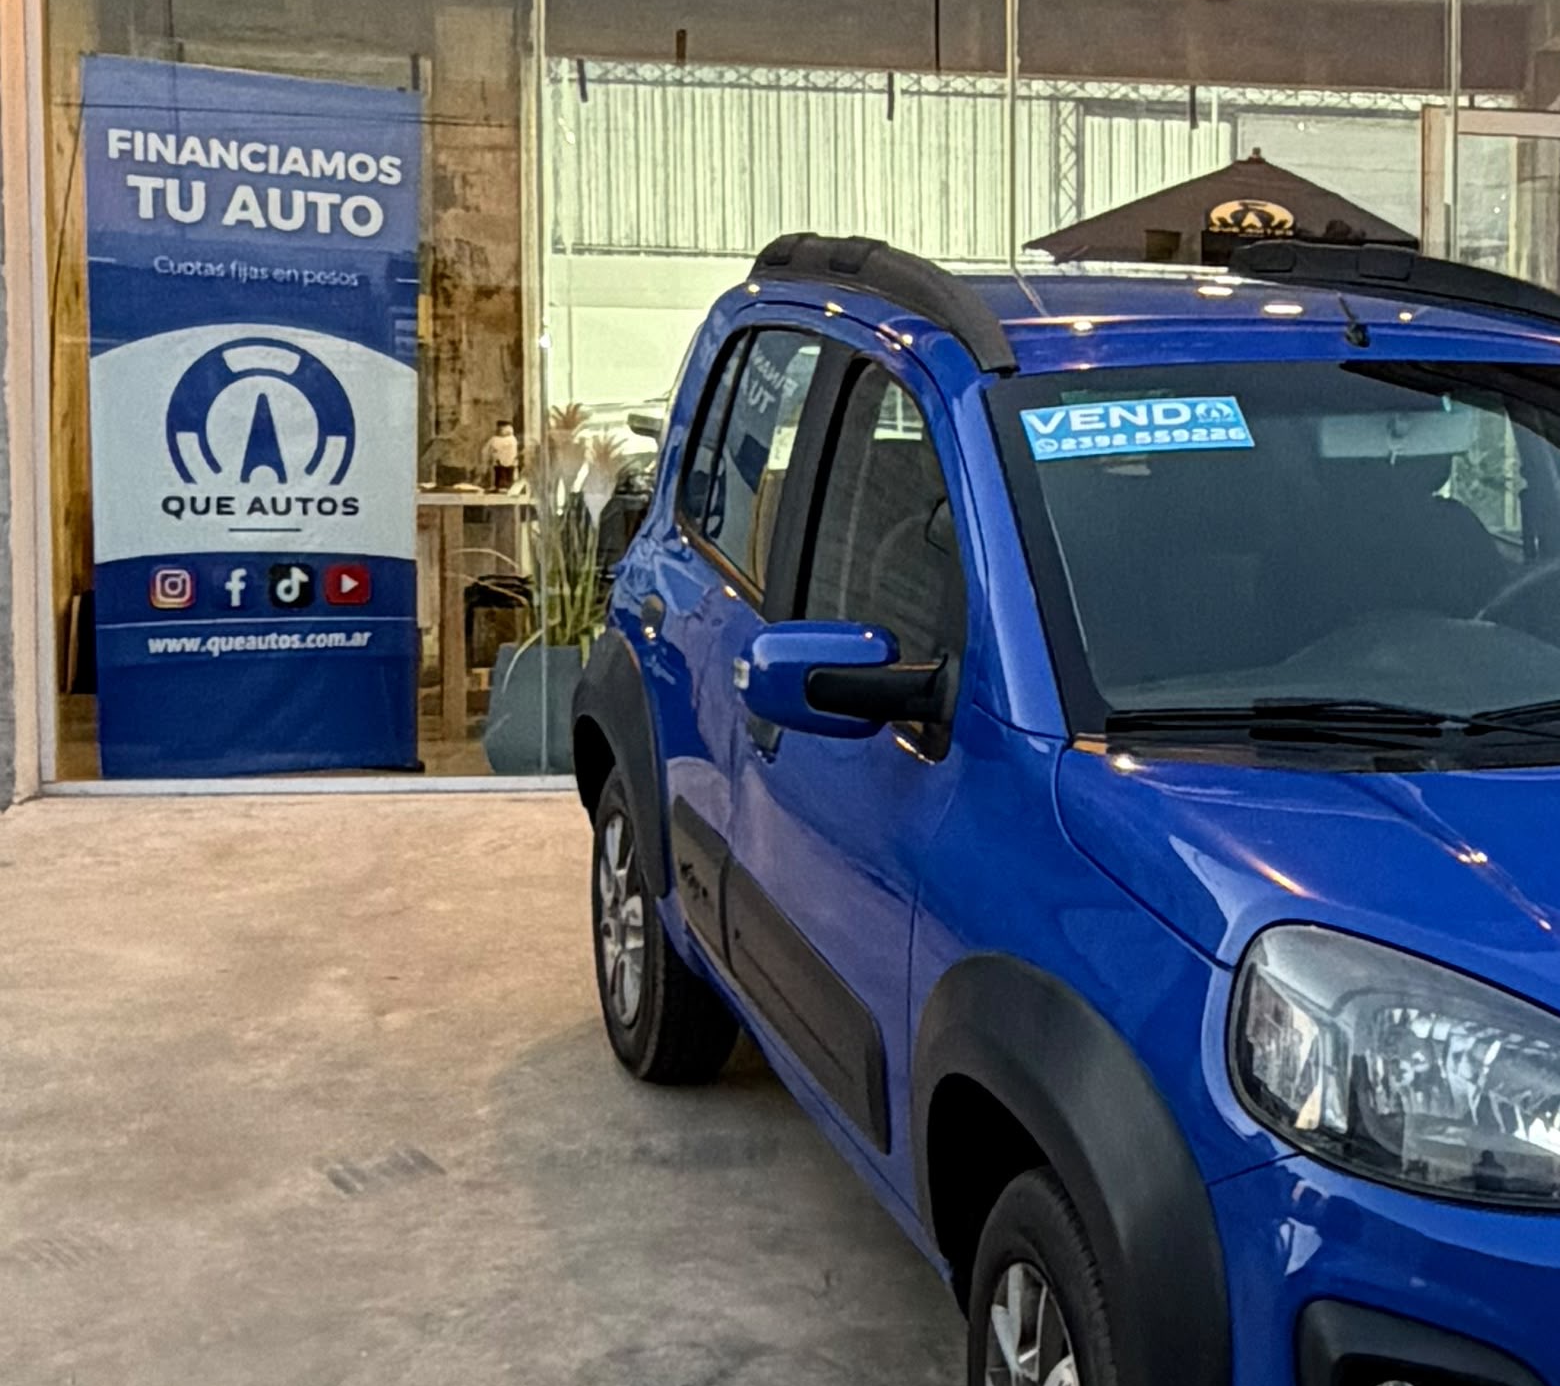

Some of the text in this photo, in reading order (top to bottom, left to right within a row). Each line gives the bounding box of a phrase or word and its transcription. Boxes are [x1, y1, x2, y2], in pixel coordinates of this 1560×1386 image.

[107, 128, 402, 186] FINANCIAMOS
[126, 174, 384, 238] TU AUTO
[153, 255, 360, 287] Cuotas fijas en pesos
[161, 494, 361, 520] QUE AUTOS
[147, 631, 373, 657] www.queautos.com.ar
